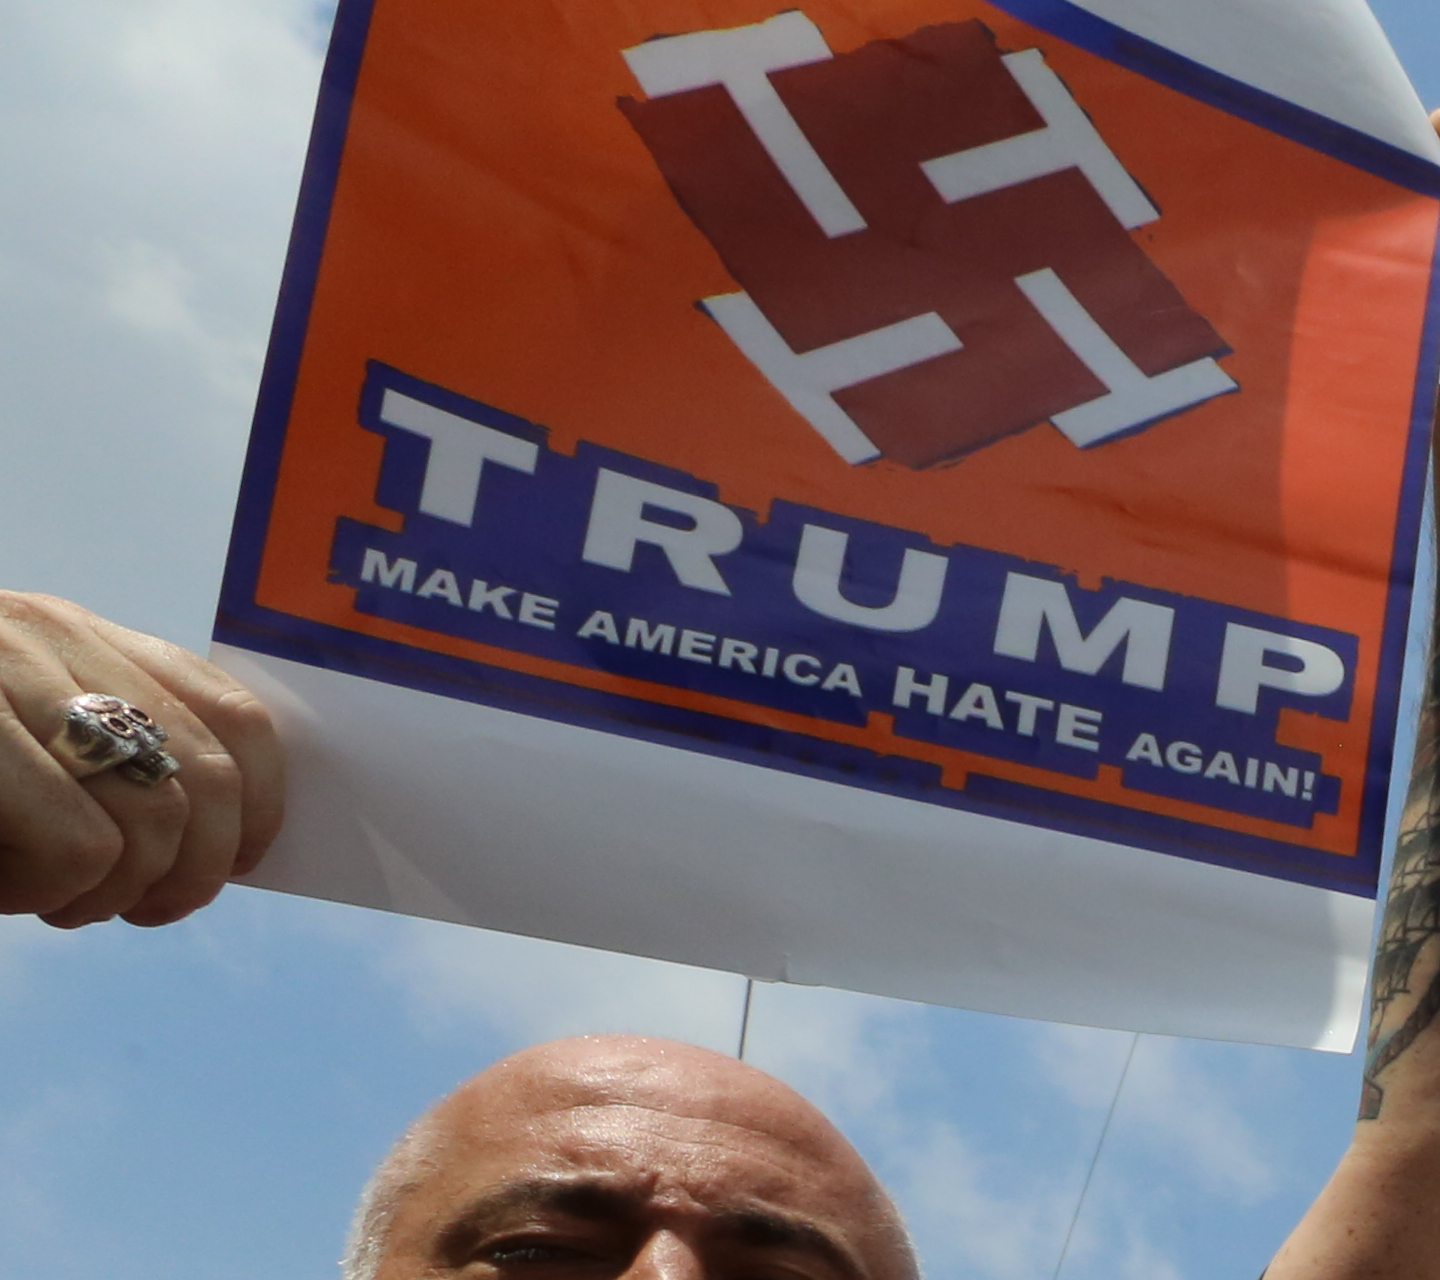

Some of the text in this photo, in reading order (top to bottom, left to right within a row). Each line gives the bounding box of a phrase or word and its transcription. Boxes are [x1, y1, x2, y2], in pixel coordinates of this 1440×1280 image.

[358, 547, 1316, 802] MAKE AMERICA HATE AGAIN!
[378, 388, 1346, 713] TRUMP
